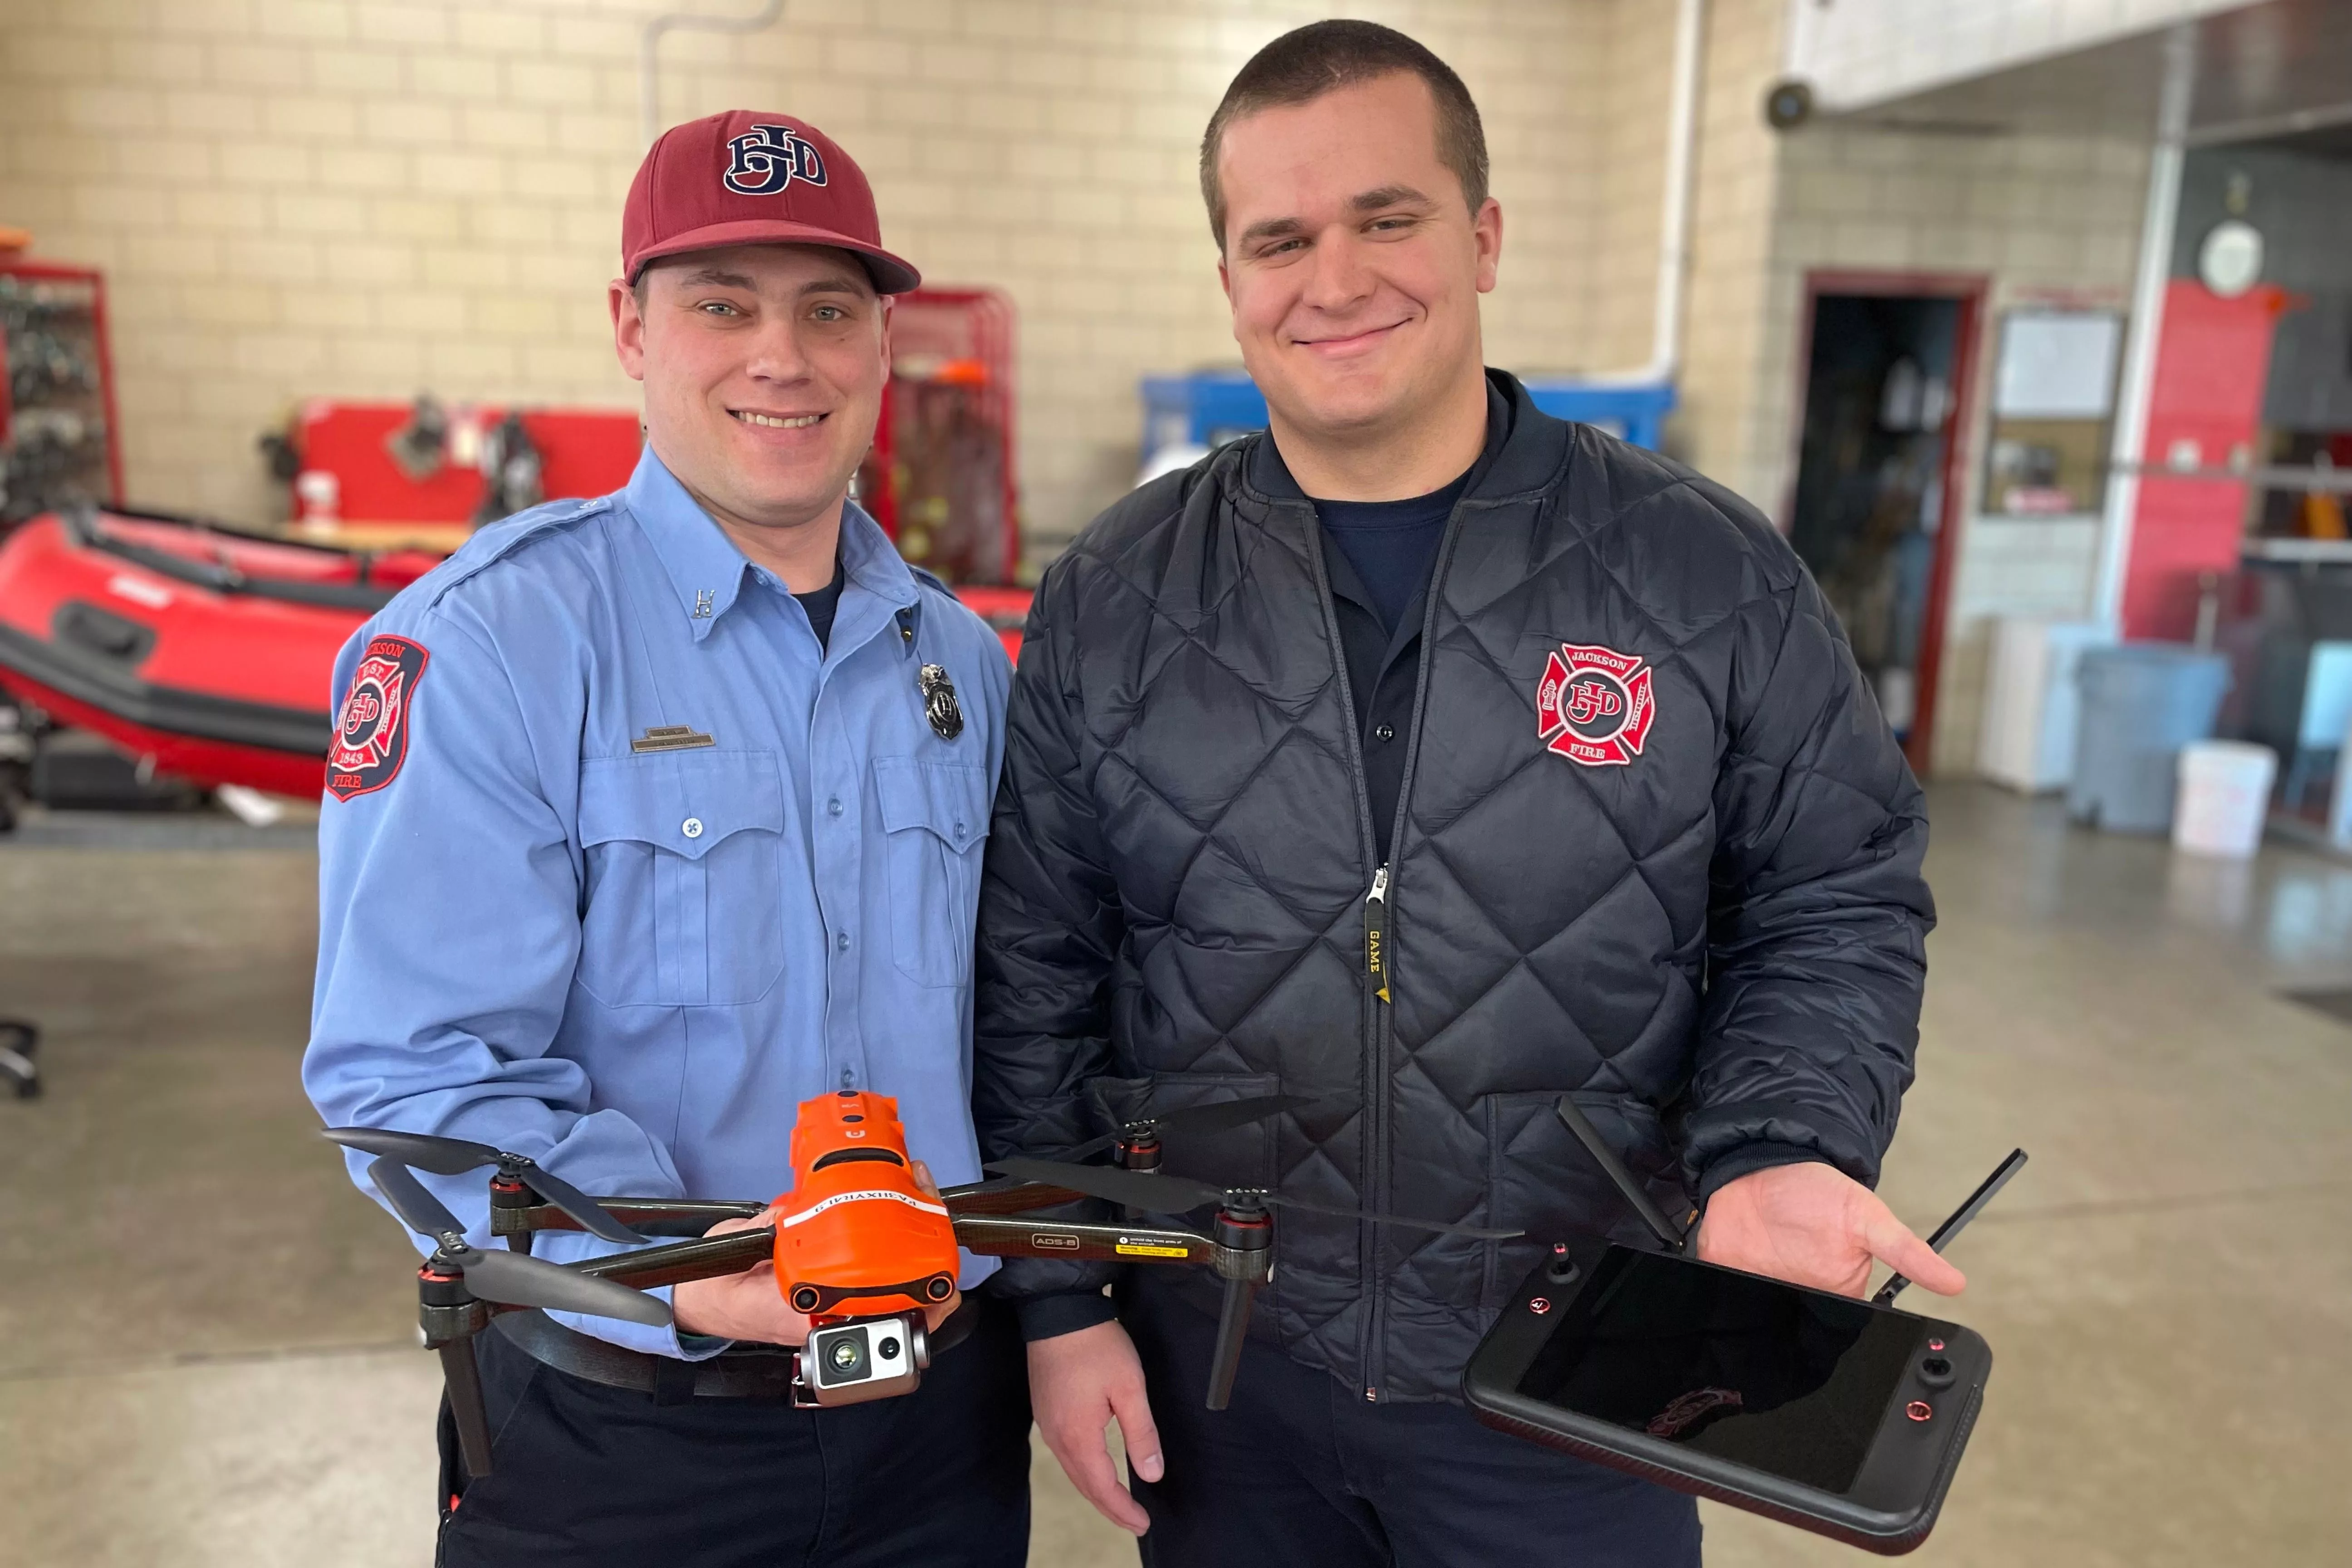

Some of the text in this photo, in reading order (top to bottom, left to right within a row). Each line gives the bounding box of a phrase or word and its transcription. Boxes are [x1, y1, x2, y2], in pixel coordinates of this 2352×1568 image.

[1572, 652, 1627, 671] JACKSON
[339, 752, 364, 764] 1843
[1570, 743, 1606, 759] FIRE
[332, 774, 362, 789] FIRE
[1370, 931, 1380, 973] GAME
